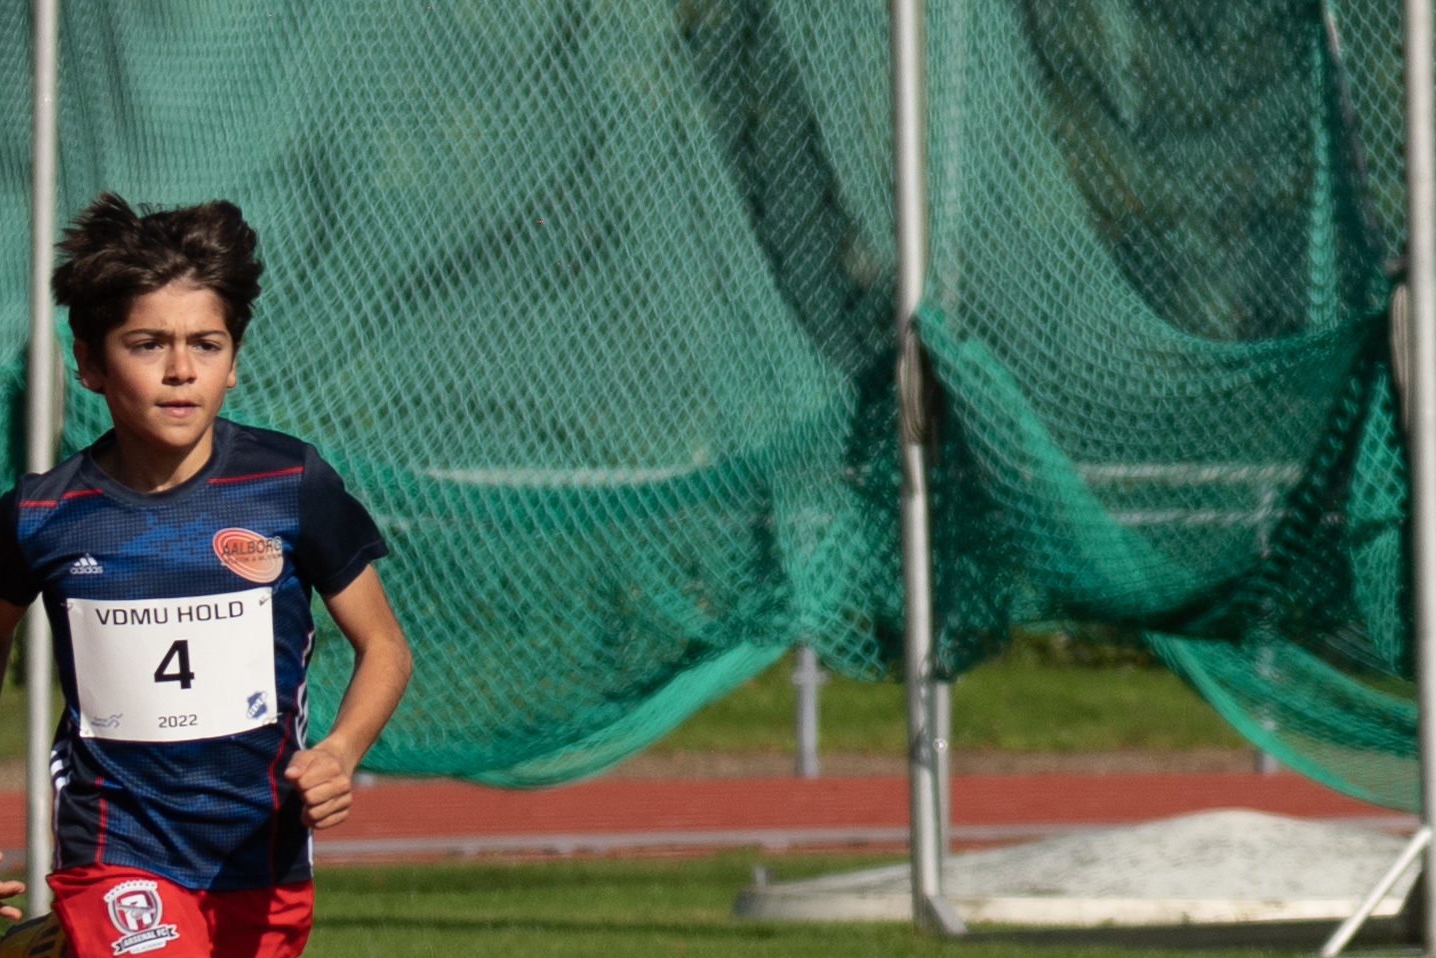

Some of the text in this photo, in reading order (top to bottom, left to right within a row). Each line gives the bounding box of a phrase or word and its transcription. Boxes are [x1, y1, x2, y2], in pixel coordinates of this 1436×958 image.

[222, 536, 282, 556] AALBORG
[69, 565, 104, 575] adidas
[95, 601, 244, 625] VDMU HOLD
[154, 639, 195, 689] 4
[158, 714, 198, 728] 2022
